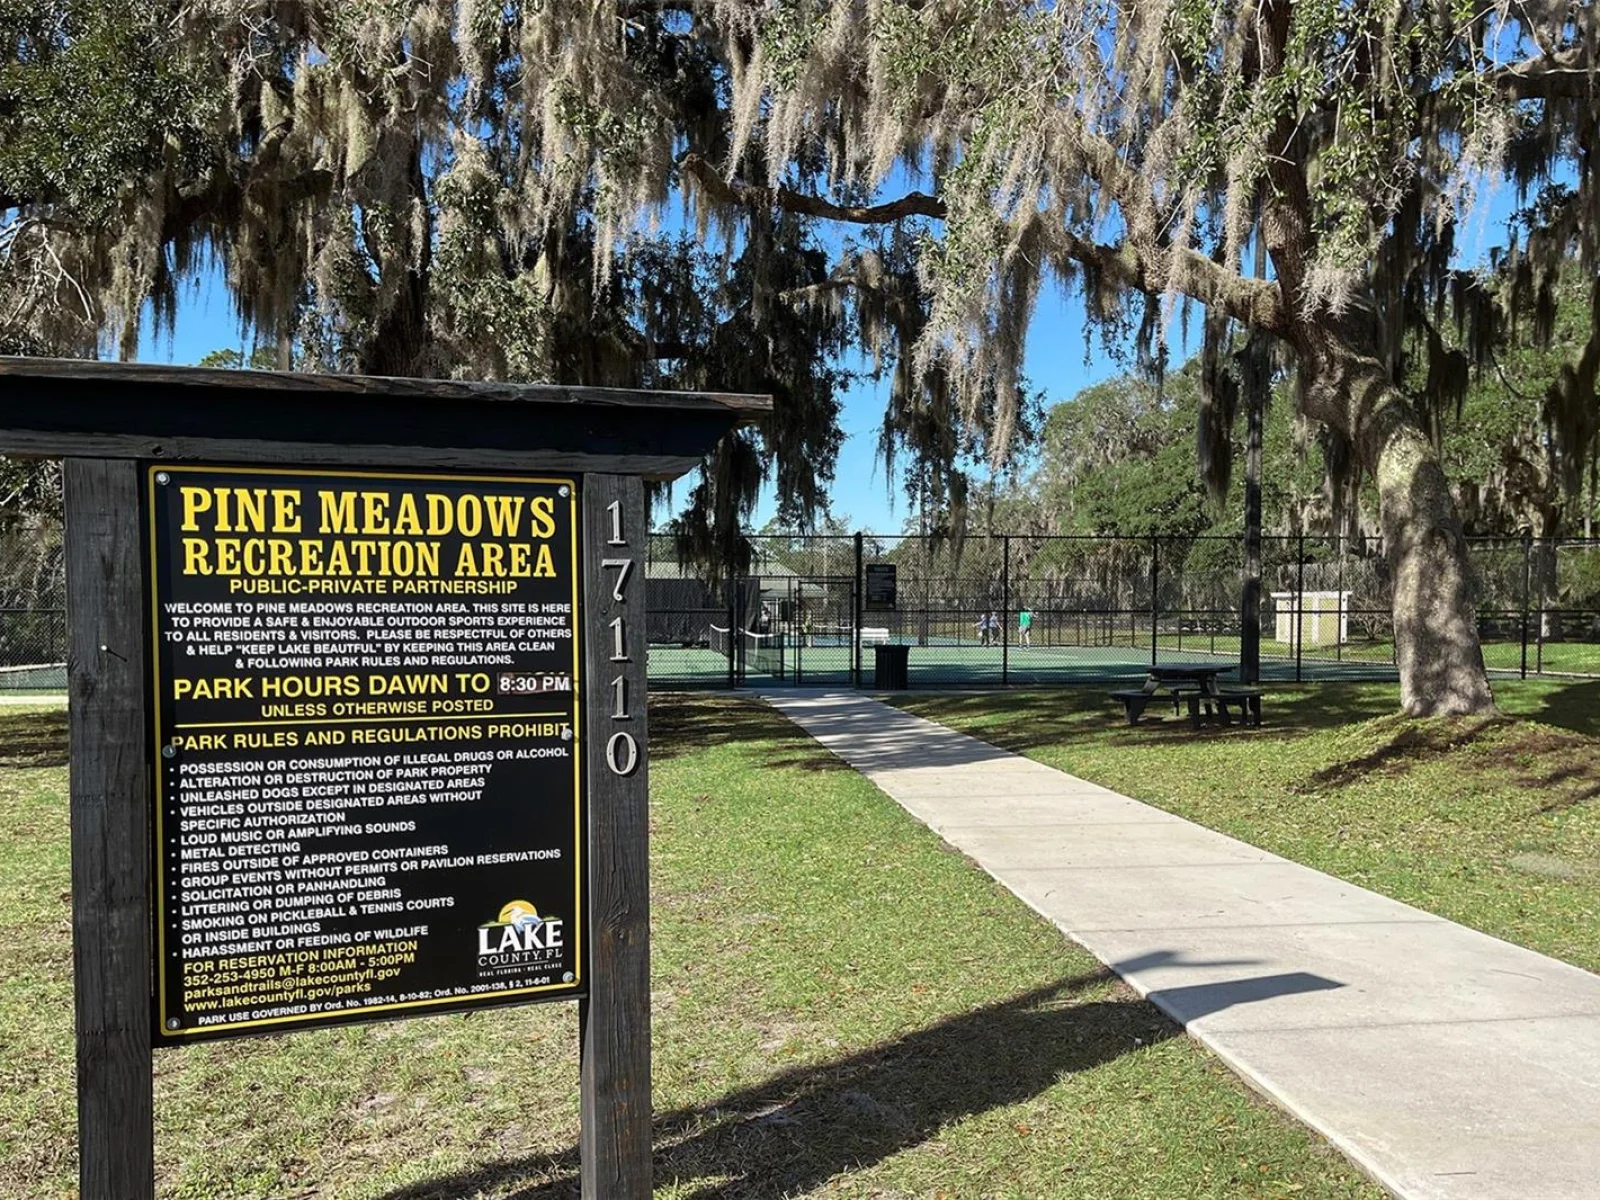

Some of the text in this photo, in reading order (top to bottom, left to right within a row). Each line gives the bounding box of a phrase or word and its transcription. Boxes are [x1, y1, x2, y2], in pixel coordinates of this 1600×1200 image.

[180, 487, 555, 539] PINE MEADOWS
[182, 537, 556, 577] RECREATION AREA
[230, 579, 517, 595] PUBLIC-PRIVATE PARTNERSHIP
[164, 602, 571, 614] WELCOME TO PINE MEADOWS RECREATION AREA. THIS SITE IS HERE
[171, 617, 566, 628] TO PROVIDE A SAFE & ENJOYABLE OUTDOOR SPORTS EXPERIENCE
[164, 628, 571, 642] TO ALL RESIDENTS & VISITORS. PLEASE BE RESPECTFUL OF OTHERS
[602, 500, 637, 775] 17110
[186, 645, 195, 656] &
[199, 645, 232, 656] HELP
[278, 644, 310, 655] LAKE
[384, 643, 400, 654] BY
[403, 643, 454, 653] KEEPING
[456, 643, 483, 653] THIS
[485, 642, 516, 652] AREA
[518, 642, 555, 652] CLEAN
[235, 655, 515, 669] & FOLLOWING PARK RULES AND REGULATIONS.
[174, 673, 490, 700] PARK HOURS DAWN TO
[500, 677, 570, 691] 8:30 PM
[261, 700, 494, 718] UNLESS OTHERWISE POSTED
[170, 723, 570, 751] PARK RULES AND REGULATIONS PROHIBIT
[179, 748, 569, 773] POSSESSION OR CONSUMPTION OF ILLEGAL DRUGS OR ALCOHOL
[180, 765, 492, 788] ALTERATION OR DESTRUCTION OF PARK PROPERTY
[180, 778, 485, 802] UNLEASHED DOGS EXCEPT IN DESIGNATED AREAS
[180, 791, 482, 816] VEHICLES OUTSIDE DESIGNATED AREAS WITHOUT
[180, 813, 345, 830] SPECIFIC AUTHORIZATION
[181, 822, 416, 844] LOUD MUSIC OR AMPLIFYING SOUNDS
[181, 843, 301, 858] METAL DETECTING
[181, 846, 448, 873] FIRES OUTSIDE OF APPROVED CONTAINERS
[181, 850, 561, 887] GROUP EVENTS WITHOUT PERMITS OR PAVILION RESERVATIONS
[181, 878, 386, 901] SOLICITATION OR PANHANDLING
[181, 890, 401, 915] LITTERING OR DUMPING OF DEBRIS
[181, 898, 454, 929] SMOKING ON PICKLEBALL & TENNIS COURTS
[182, 923, 320, 943] OR INSIDE BUILDINGS
[182, 927, 428, 958] HARASSMENT OR FEEDING OF WILDLIFE
[478, 920, 563, 955] LAKE
[184, 942, 417, 973] FOR RESERVATION INFORMATION
[545, 948, 563, 960] FL
[183, 967, 275, 986] 352-253-4950
[279, 965, 304, 976] M-F
[307, 959, 356, 973] 8:00AM
[368, 954, 415, 967] 5:00PM
[184, 968, 401, 1001] parksandtrails@lakecountyfl.gov
[183, 982, 371, 1012] www.lakecountyfl.gov/parks
[198, 1002, 323, 1026] PARK USE GOVERNED BY
